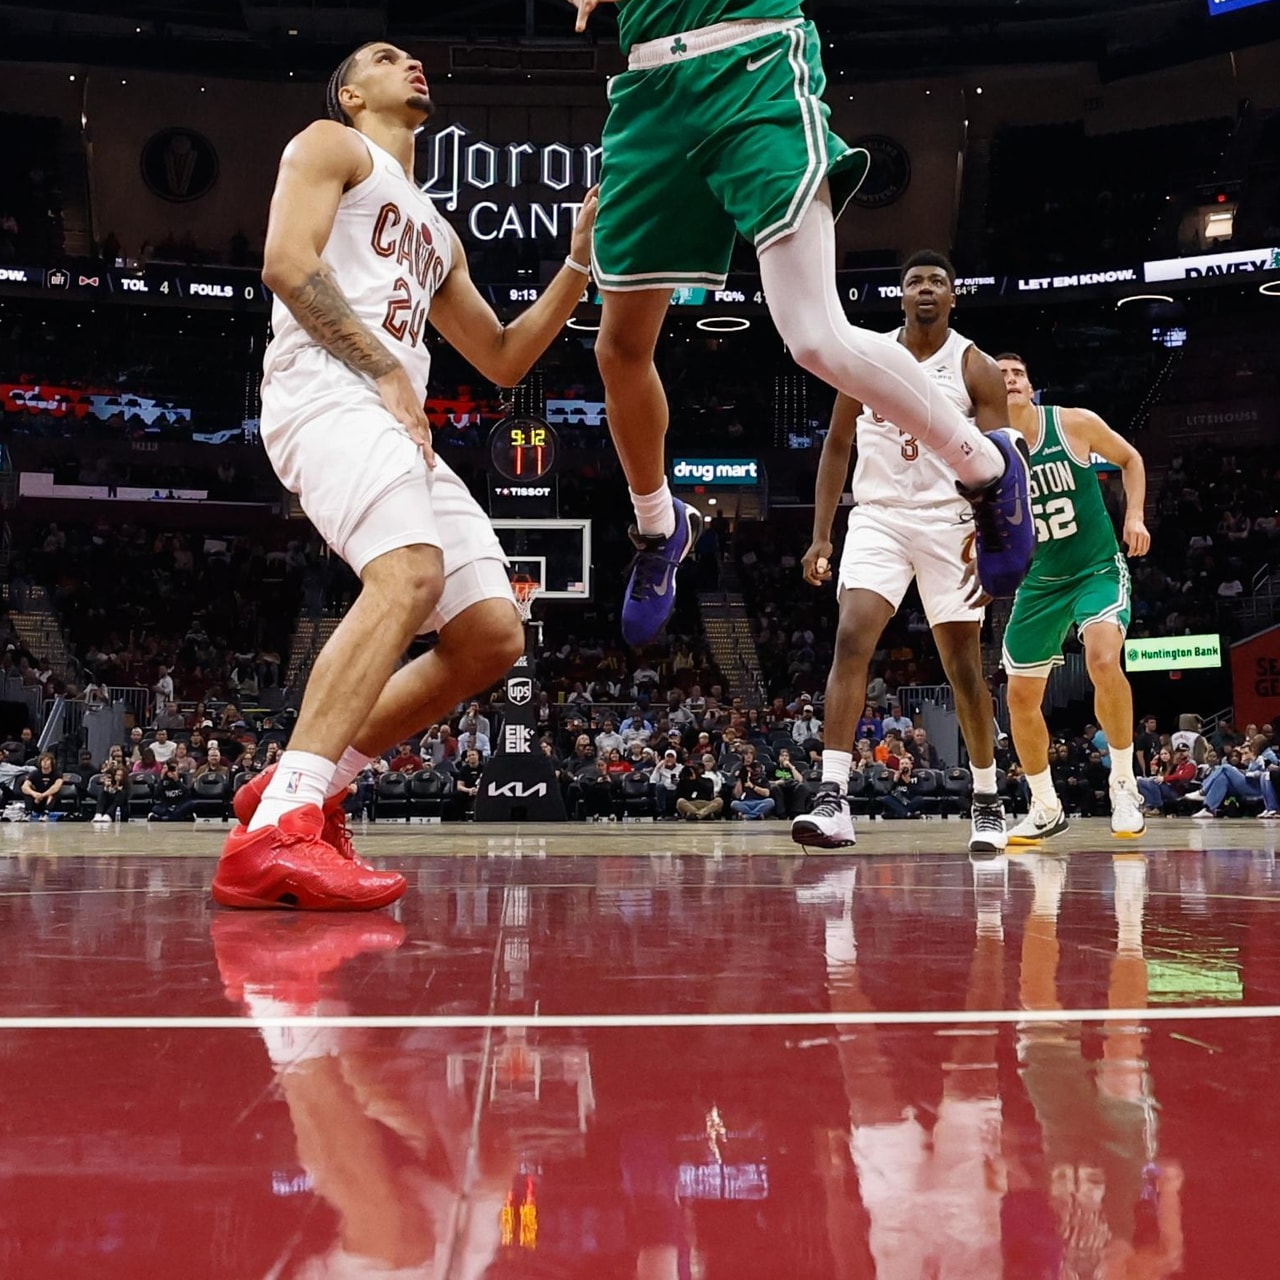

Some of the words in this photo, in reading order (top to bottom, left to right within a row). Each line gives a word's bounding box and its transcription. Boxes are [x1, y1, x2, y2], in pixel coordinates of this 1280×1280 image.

[470, 201, 586, 240] CANT
[121, 278, 149, 291] TOL
[159, 281, 169, 294] 4
[964, 276, 995, 285] OUTSIDE
[1019, 278, 1052, 291] LET
[1052, 275, 1079, 288] EM
[1079, 269, 1137, 286] KNOW.
[190, 283, 234, 297] FOULS
[244, 286, 254, 299] 0
[509, 288, 537, 301] 9:13
[714, 290, 745, 302] FG%
[878, 285, 904, 298] TOL
[900, 432, 919, 462] 3
[673, 461, 713, 481] drug
[716, 461, 758, 478] mart
[1031, 497, 1078, 543] 52
[1141, 647, 1192, 661] Huntington
[1194, 646, 1218, 657] Bank
[510, 683, 530, 701] ups
[505, 739, 531, 753] Elk
